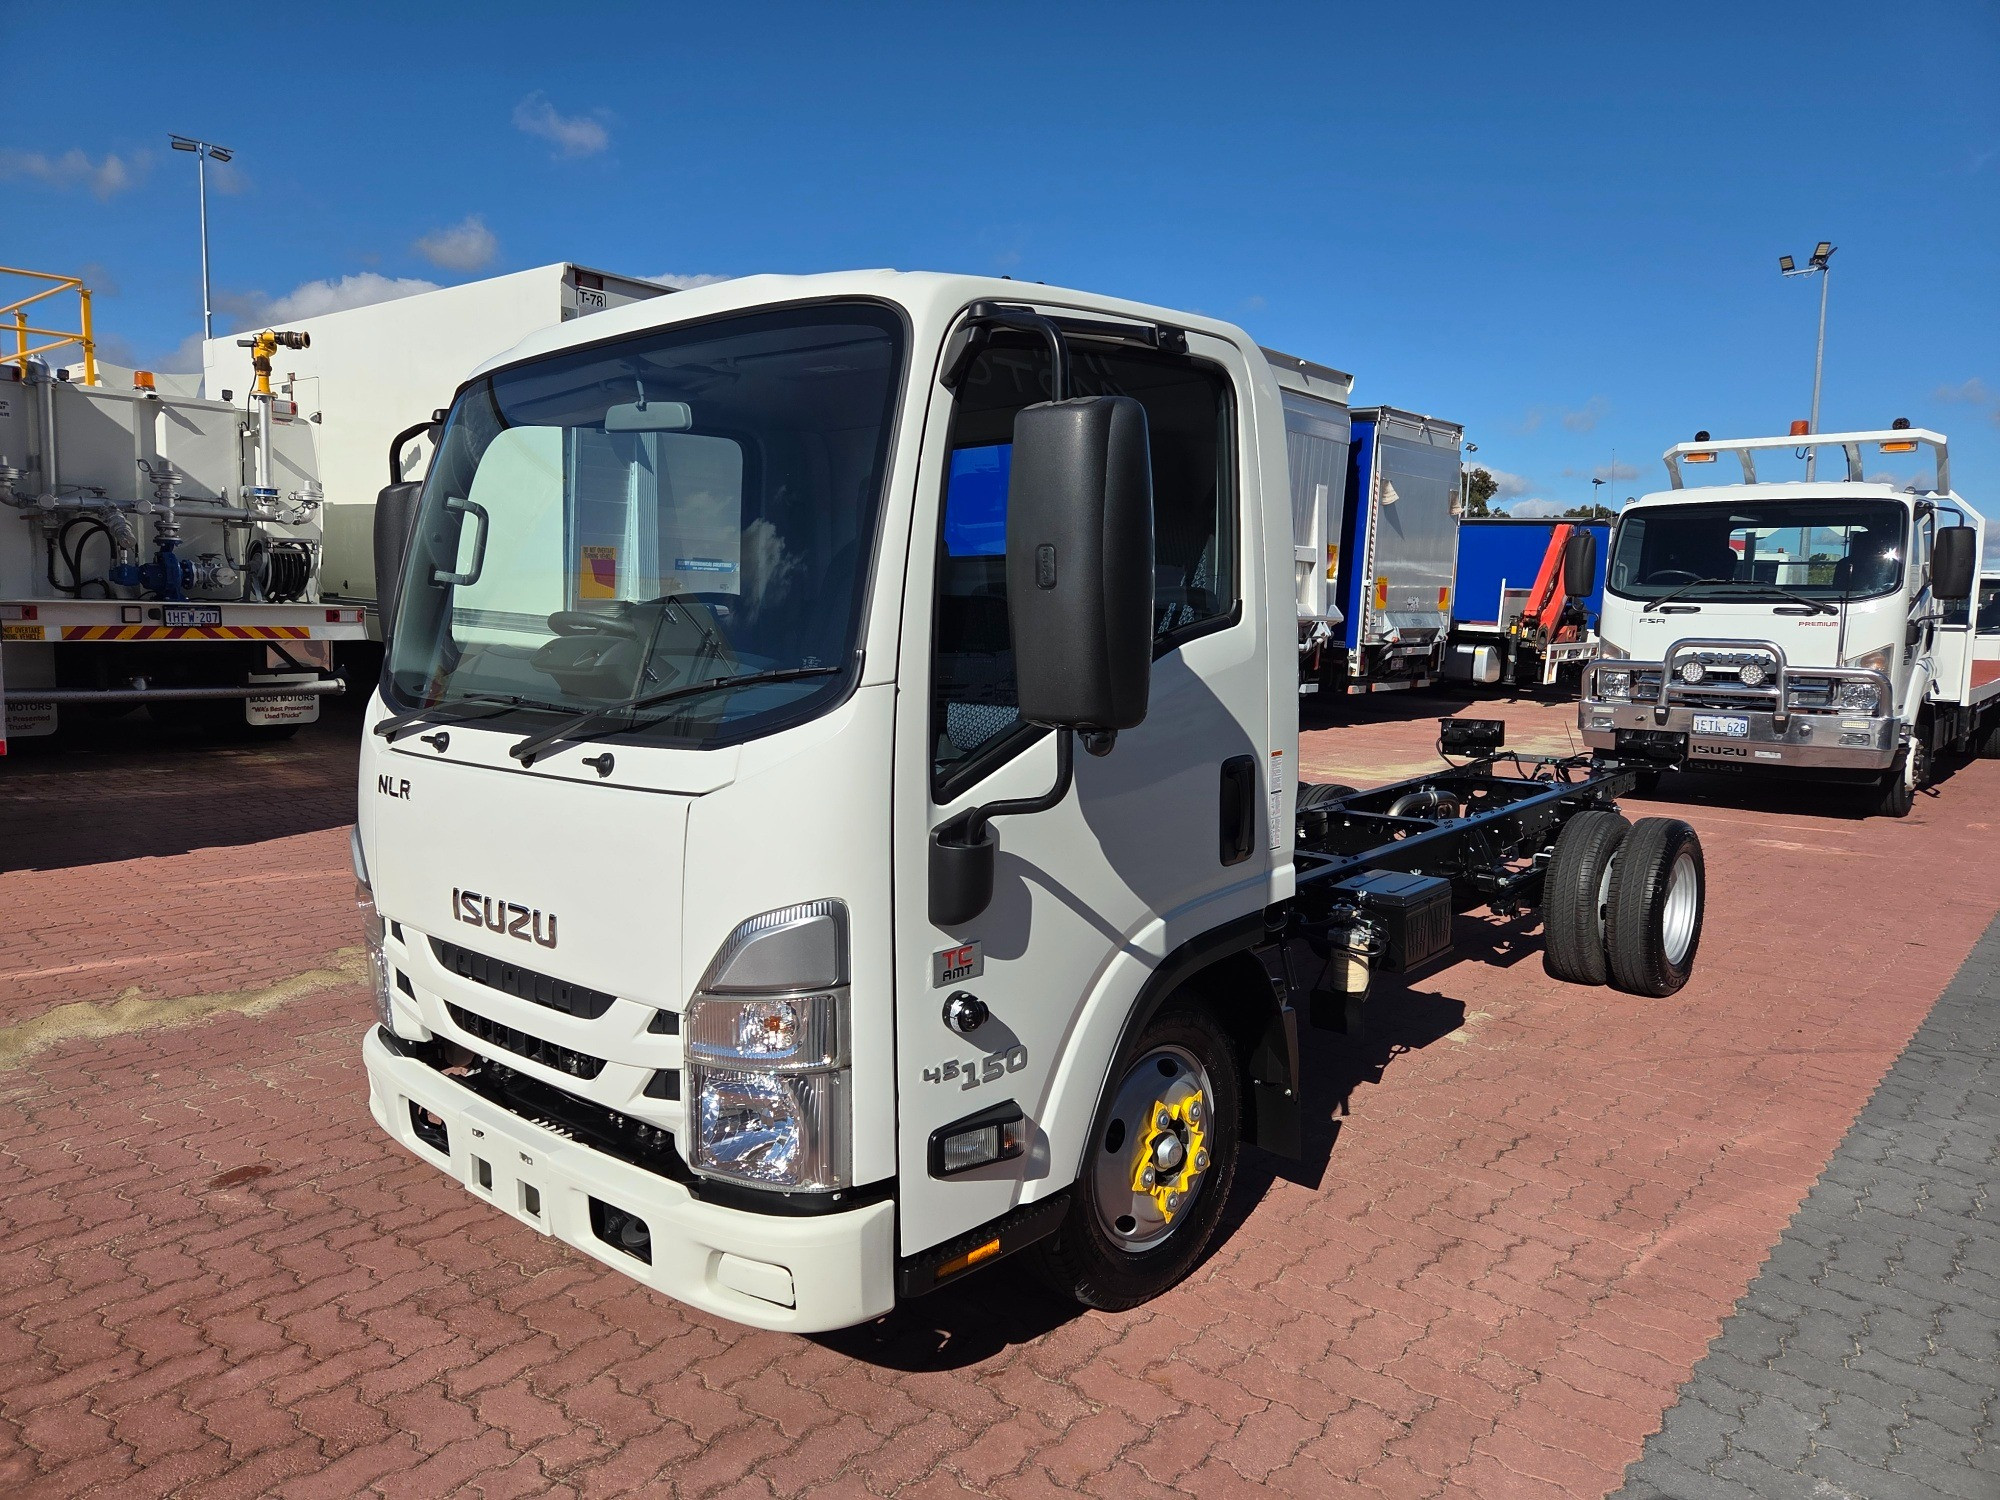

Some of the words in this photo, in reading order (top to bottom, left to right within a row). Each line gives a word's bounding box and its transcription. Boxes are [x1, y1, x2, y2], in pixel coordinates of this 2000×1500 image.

[580, 291, 604, 307] T-78
[8, 703, 53, 711] MOTORS
[281, 694, 315, 702] MOTORS
[1692, 745, 1748, 757] ISUZU
[378, 774, 411, 801] NLR
[452, 887, 559, 949] ISUZU
[942, 946, 973, 969] TC
[942, 964, 973, 982] AMT
[961, 1044, 1028, 1092] 150
